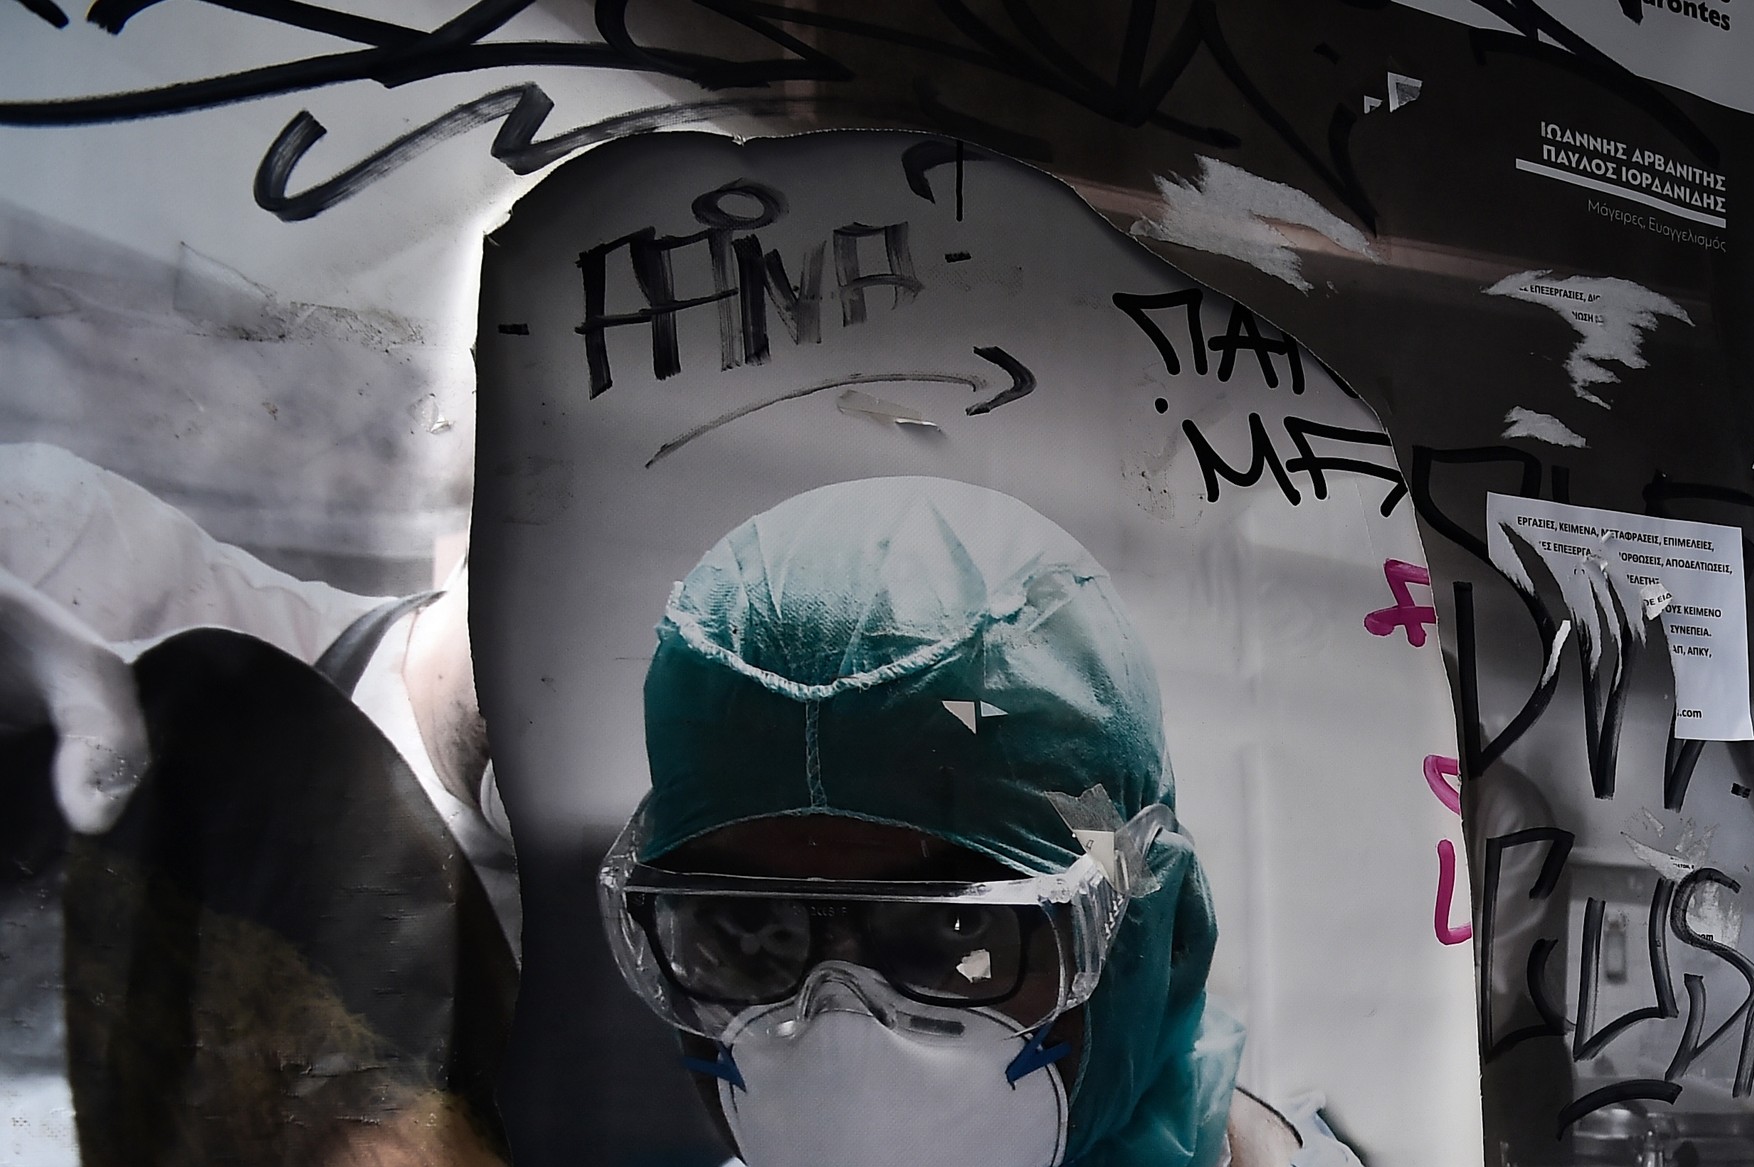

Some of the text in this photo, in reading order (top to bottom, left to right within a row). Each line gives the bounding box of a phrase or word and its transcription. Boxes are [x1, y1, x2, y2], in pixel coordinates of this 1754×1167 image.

[1541, 121, 1726, 191] ΙΩΑΝΝΗΣ ΑΡΒΑΝΙΤΗΣ
[1543, 144, 1726, 213] ΠΑΥΛΟΣ ΙΟΡΔΑΝΙΔΗΣ
[1588, 199, 1727, 252] Μάγειρες, Ευαγγελισμός
[1517, 516, 1558, 531] ΕΡΓΑΣΙΕΣ,
[1559, 522, 1599, 538] ΚΕΙΜΕΝΑ,
[1663, 536, 1715, 552] ΕΠΙΜΕΛΕΙΕΣ,
[1619, 552, 1664, 567] ΟΡΘΩΣΕΙΣ,
[1665, 558, 1733, 574] ΑΠΟΔΕΛΤΙΩΣΕΙΣ,
[1684, 606, 1722, 617] ΚΕΙΜΕΝΟ
